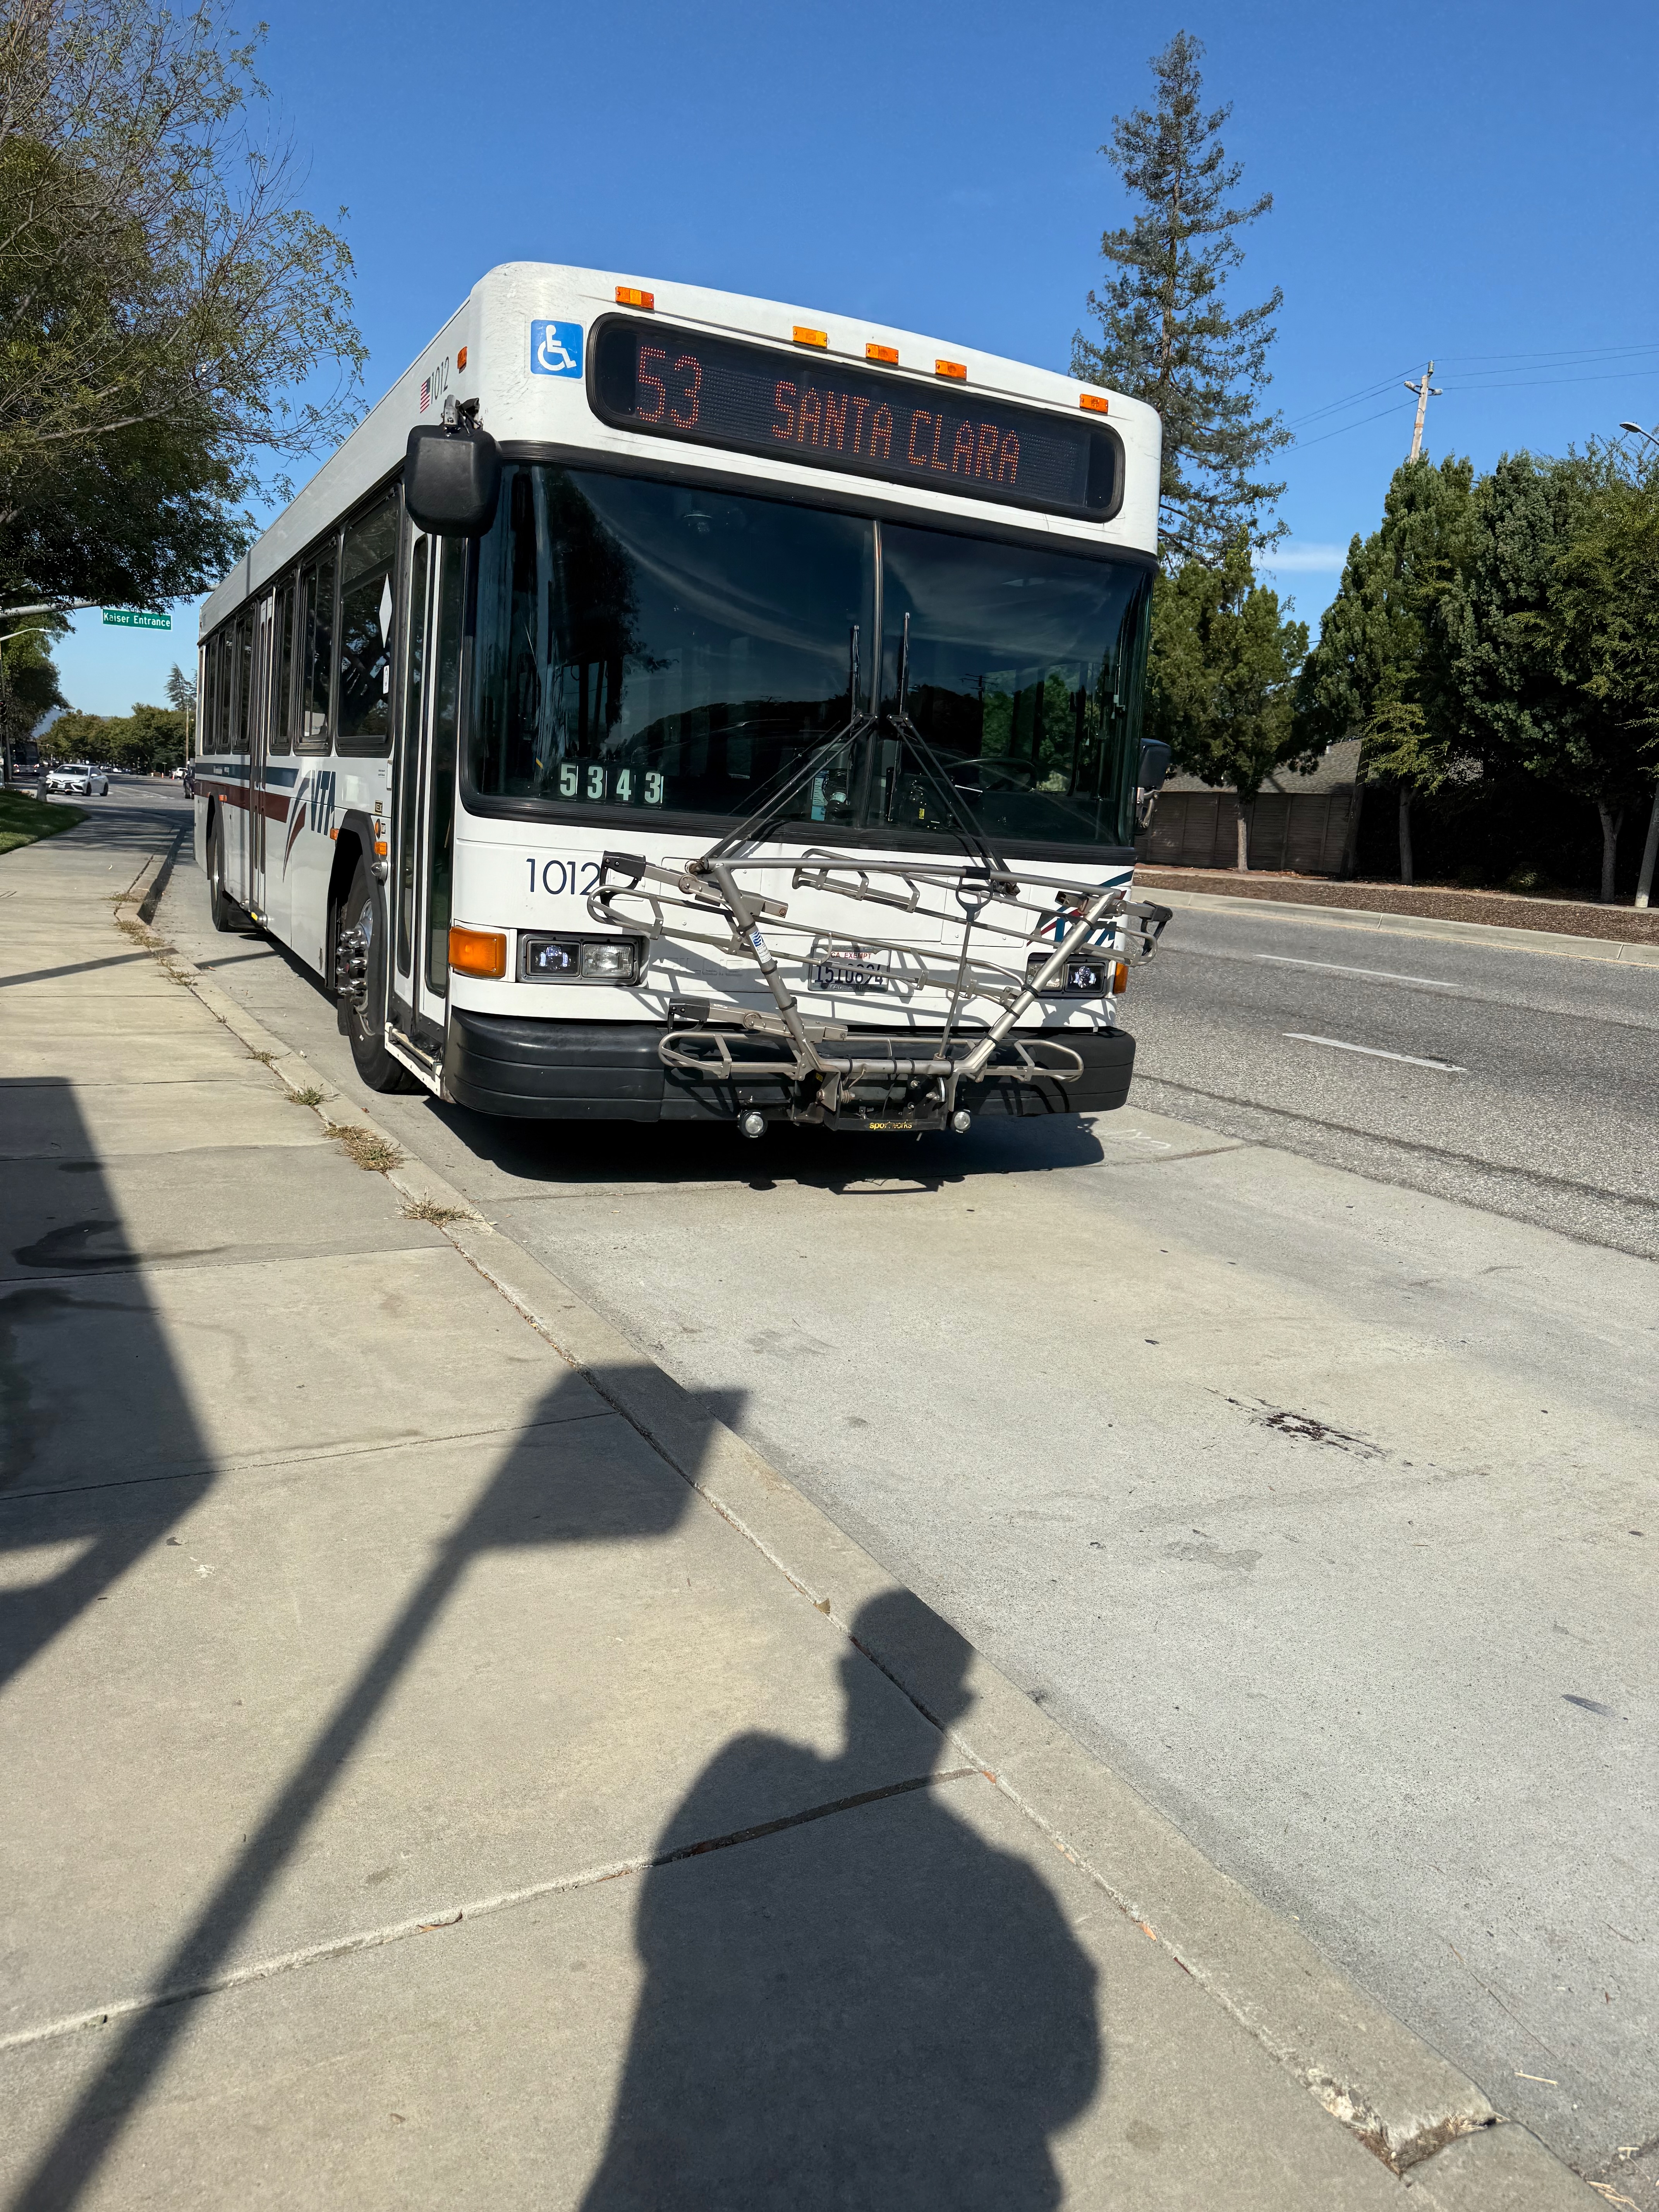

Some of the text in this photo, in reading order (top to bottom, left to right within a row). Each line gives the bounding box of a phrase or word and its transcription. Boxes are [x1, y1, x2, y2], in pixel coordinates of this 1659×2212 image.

[431, 356, 449, 404] 1012
[637, 346, 1020, 483] 53 SANTA CLARA
[104, 612, 170, 627] Kaiser Entrance
[526, 858, 601, 895] 1012
